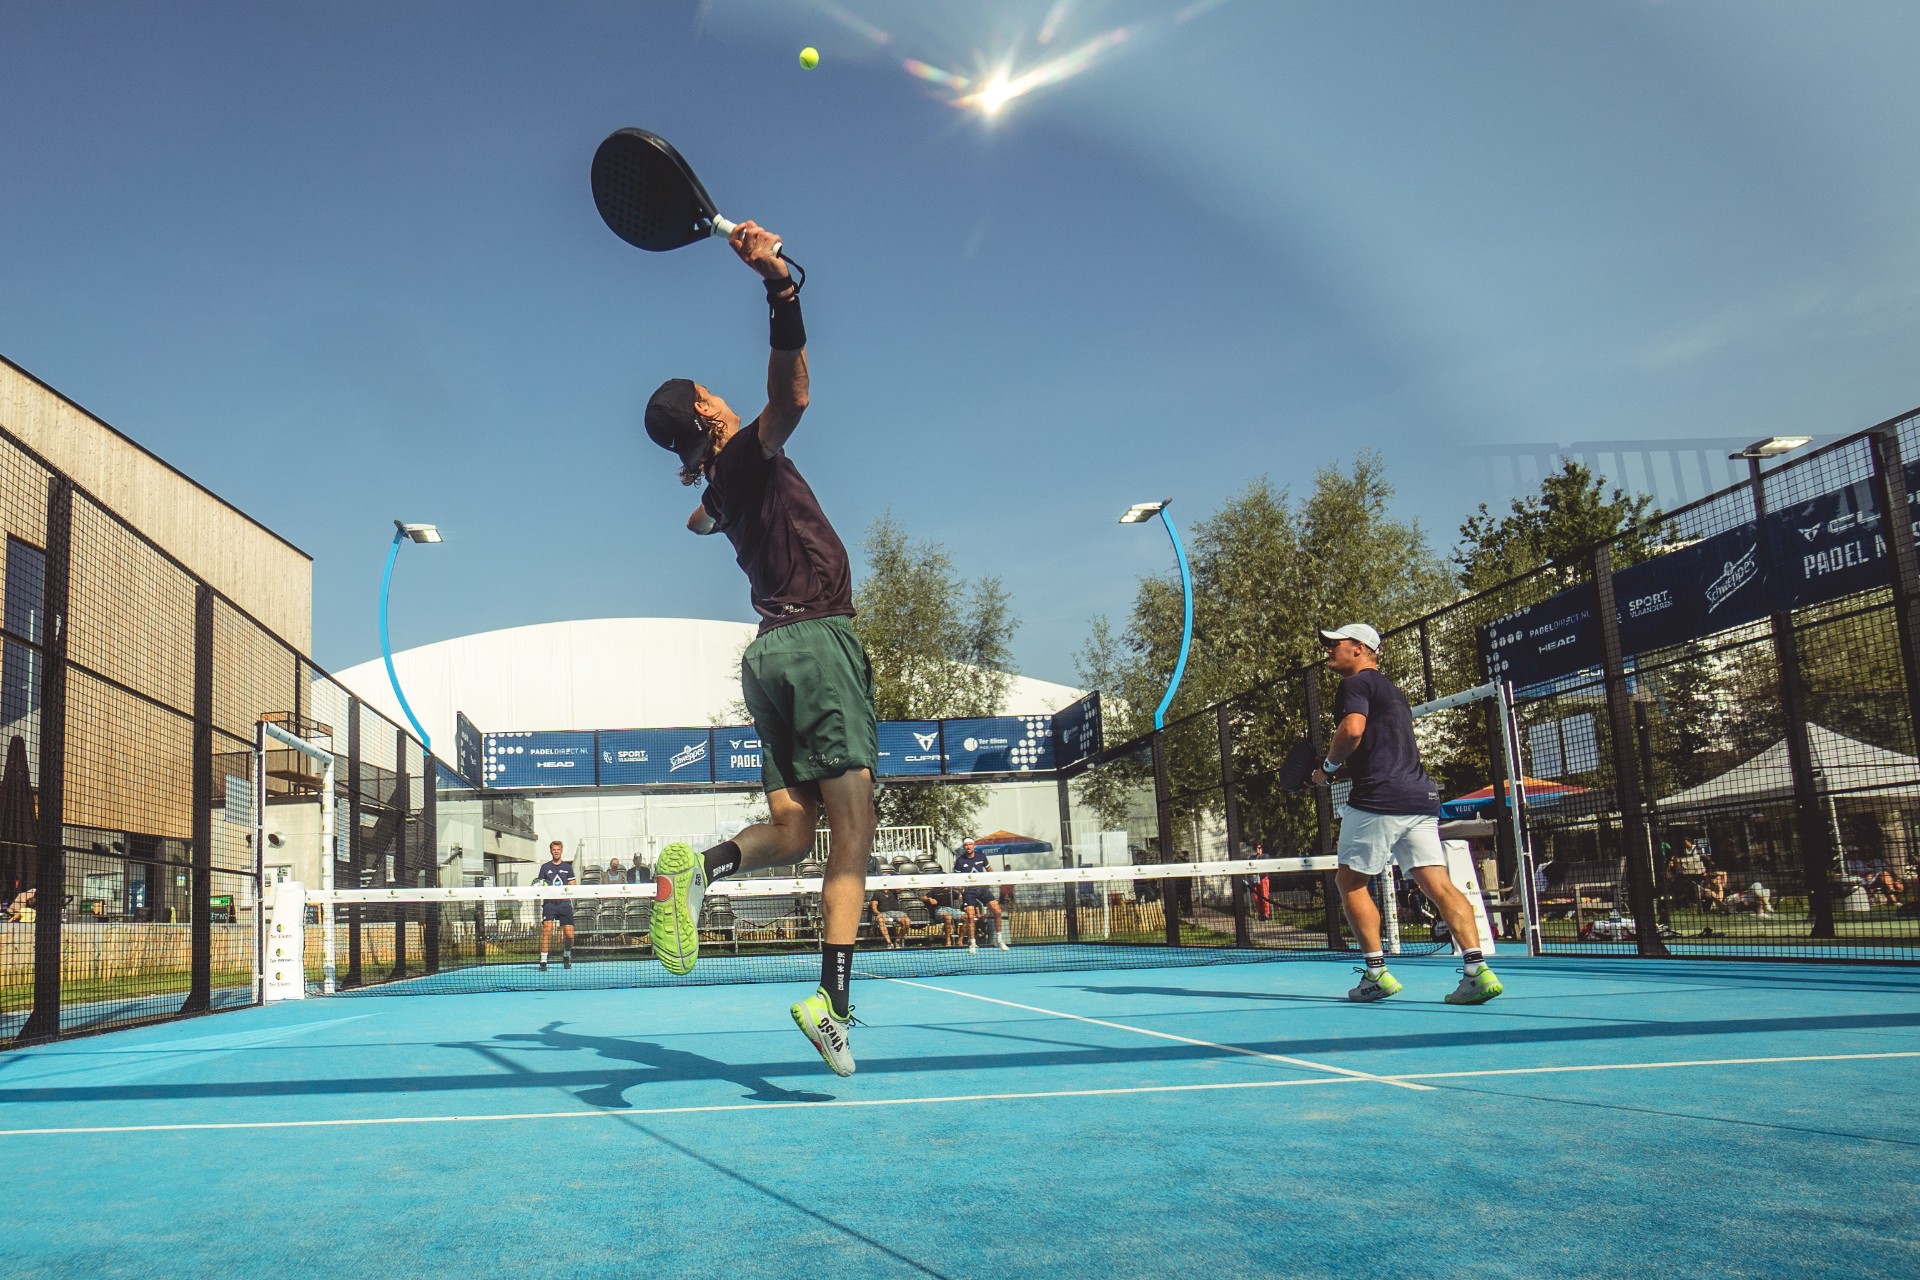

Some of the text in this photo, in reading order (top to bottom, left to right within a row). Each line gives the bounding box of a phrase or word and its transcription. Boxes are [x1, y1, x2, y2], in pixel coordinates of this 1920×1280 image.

[1804, 541, 1869, 579] PADEL
[1706, 553, 1756, 603] Schweppes
[1630, 601, 1673, 618] VLAANDEREN
[1529, 609, 1591, 638] PADELDIRECT.NL
[1539, 635, 1576, 654] HEAD
[670, 746, 705, 768] Schweppes
[731, 754, 763, 768] PADEL
[1360, 983, 1382, 996] OSAKA
[818, 1017, 844, 1053] OSAKA
